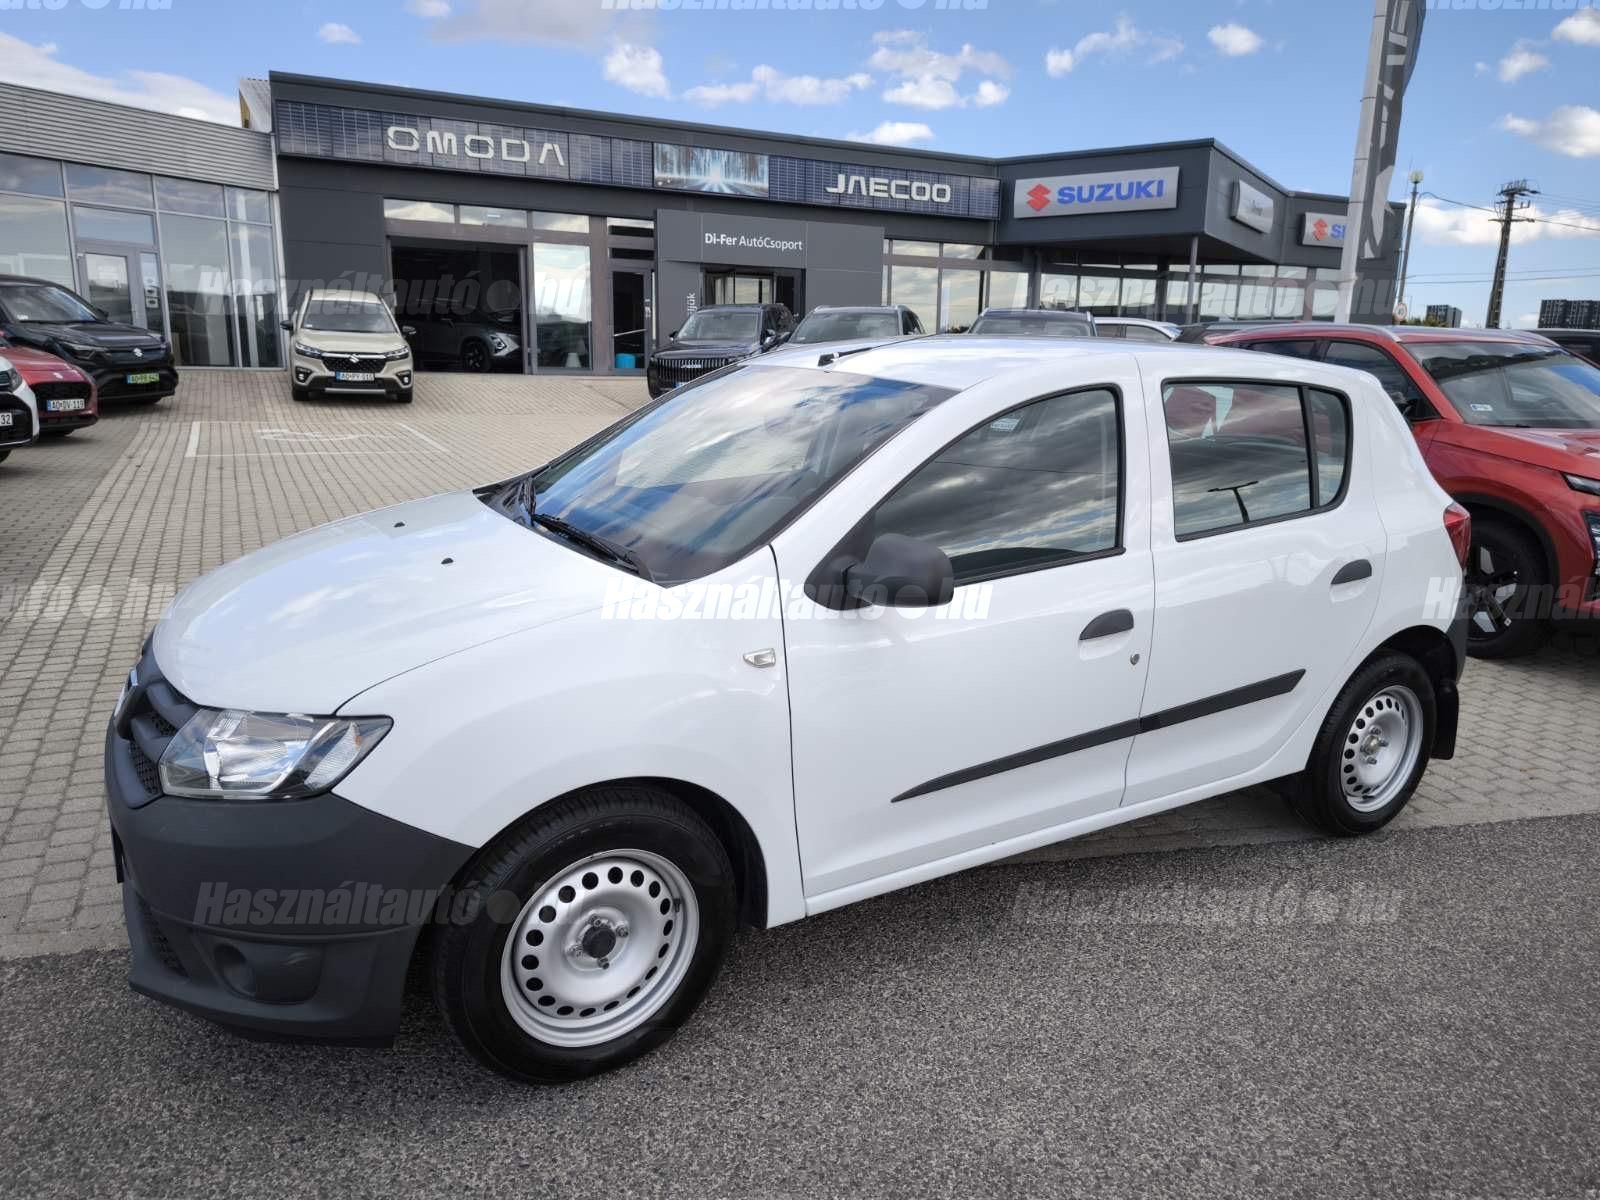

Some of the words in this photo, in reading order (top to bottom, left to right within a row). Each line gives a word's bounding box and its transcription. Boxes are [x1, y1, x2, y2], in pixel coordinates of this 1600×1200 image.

[387, 126, 565, 166] OMODA
[826, 174, 951, 202] JAECOO
[1057, 179, 1165, 205] SUZUKI
[704, 232, 738, 246] Di-Fer
[739, 236, 803, 252] AutóCsoport
